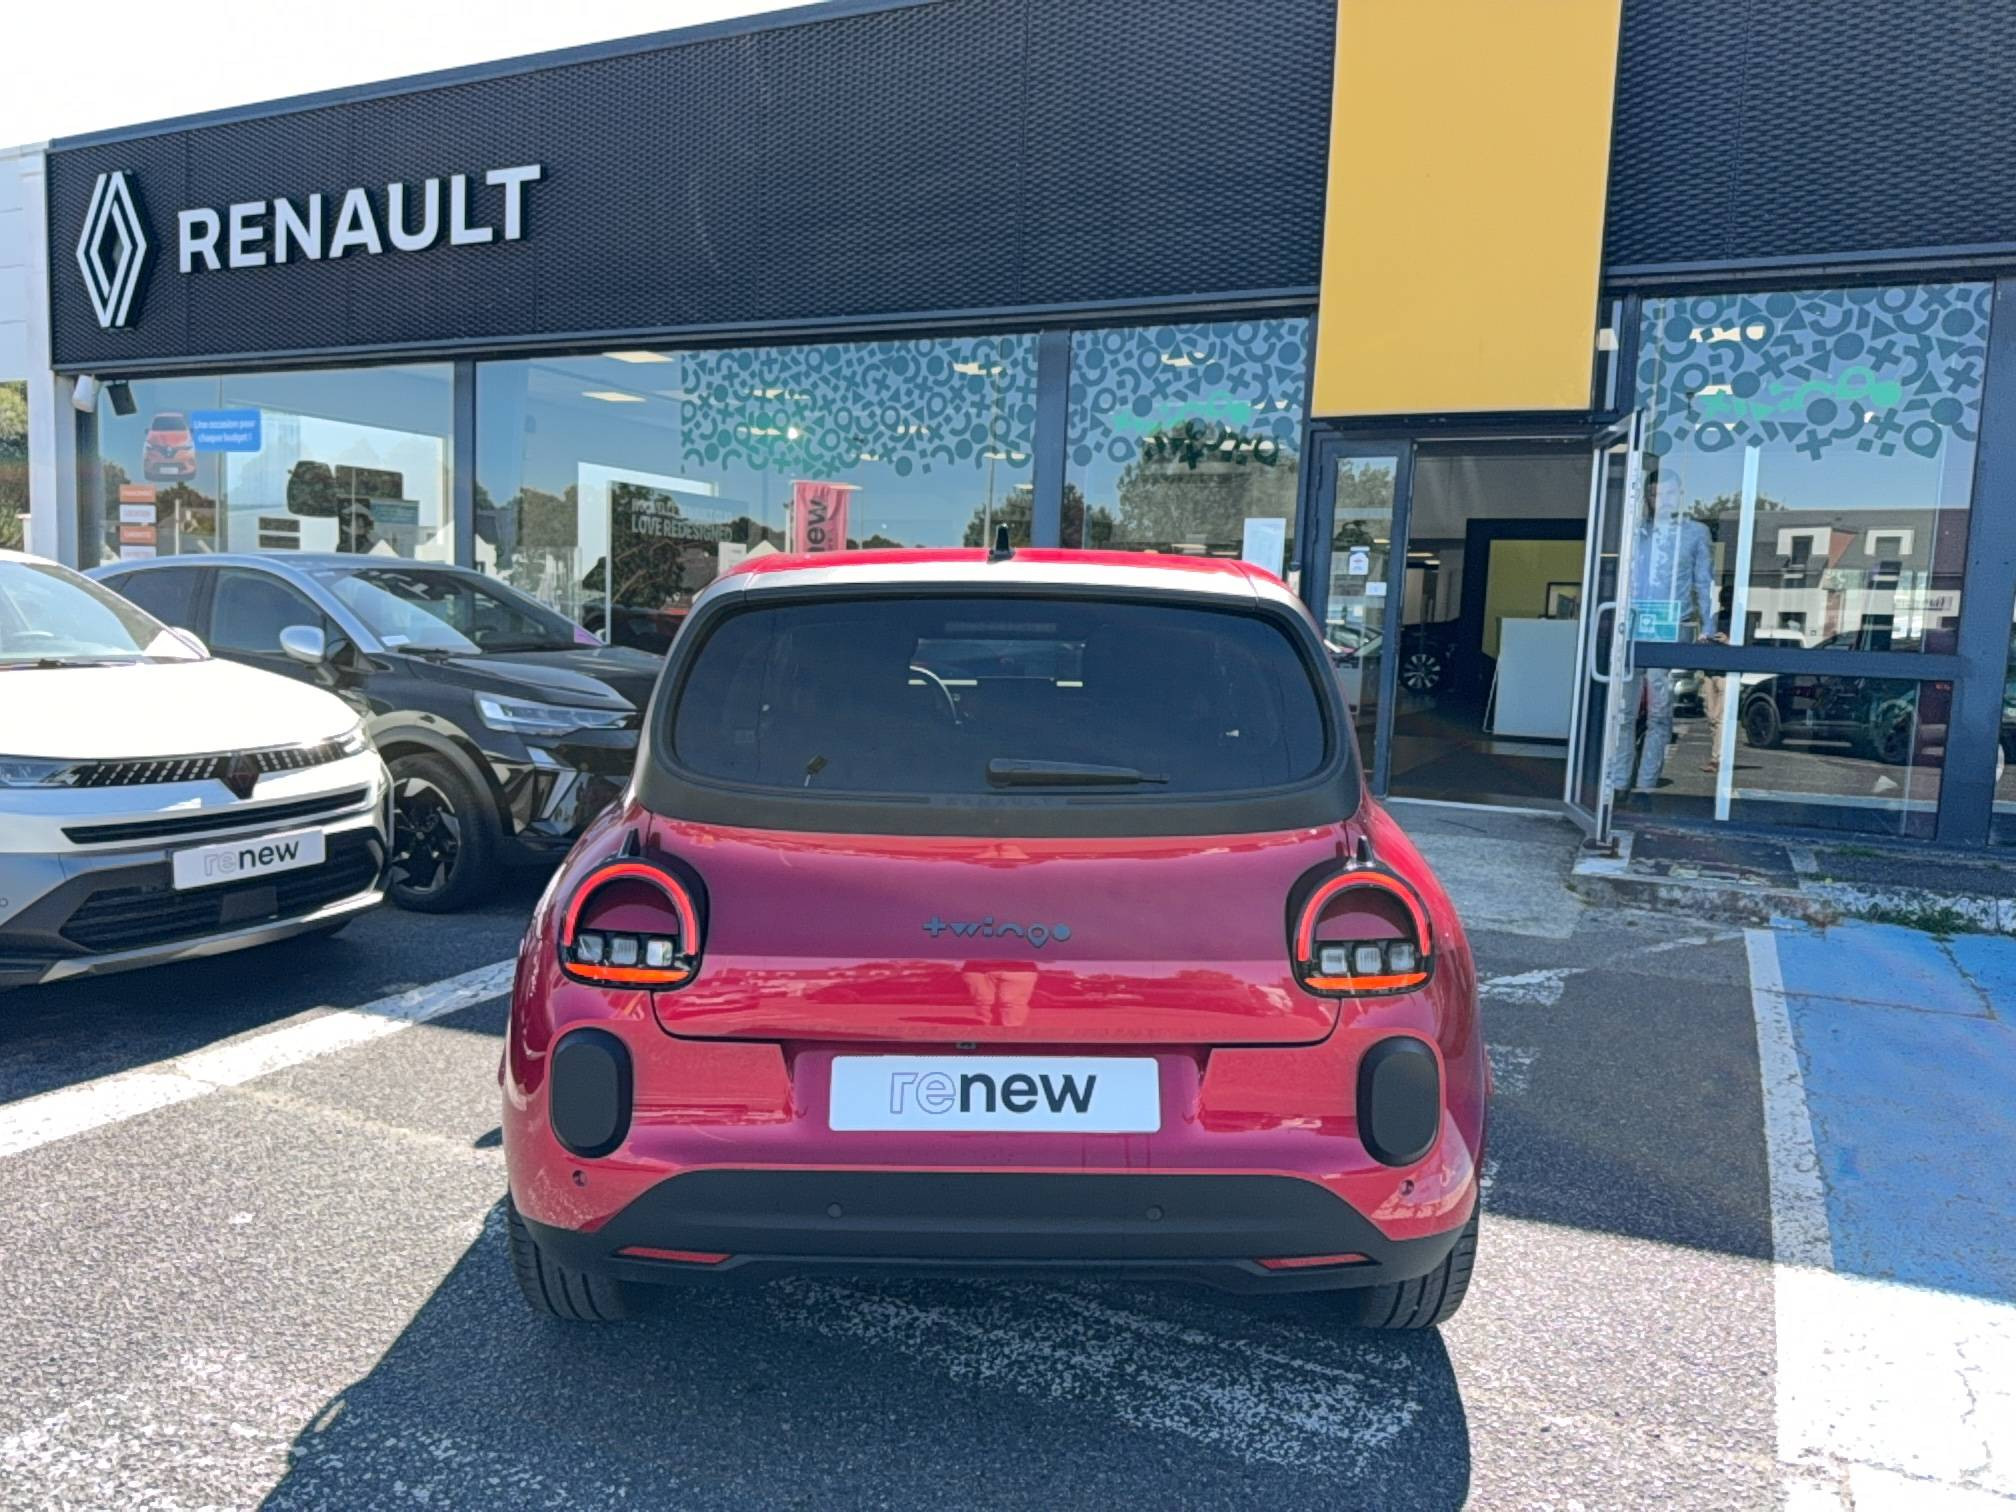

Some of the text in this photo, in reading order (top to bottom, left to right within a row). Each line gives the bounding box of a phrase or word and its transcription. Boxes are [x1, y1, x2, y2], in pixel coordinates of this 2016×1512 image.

[178, 164, 541, 273] RENAULT
[631, 514, 733, 542] LOVE REDESIGNED
[204, 840, 300, 877] renew
[922, 915, 1072, 949] twingo
[889, 1071, 1098, 1115] renew
